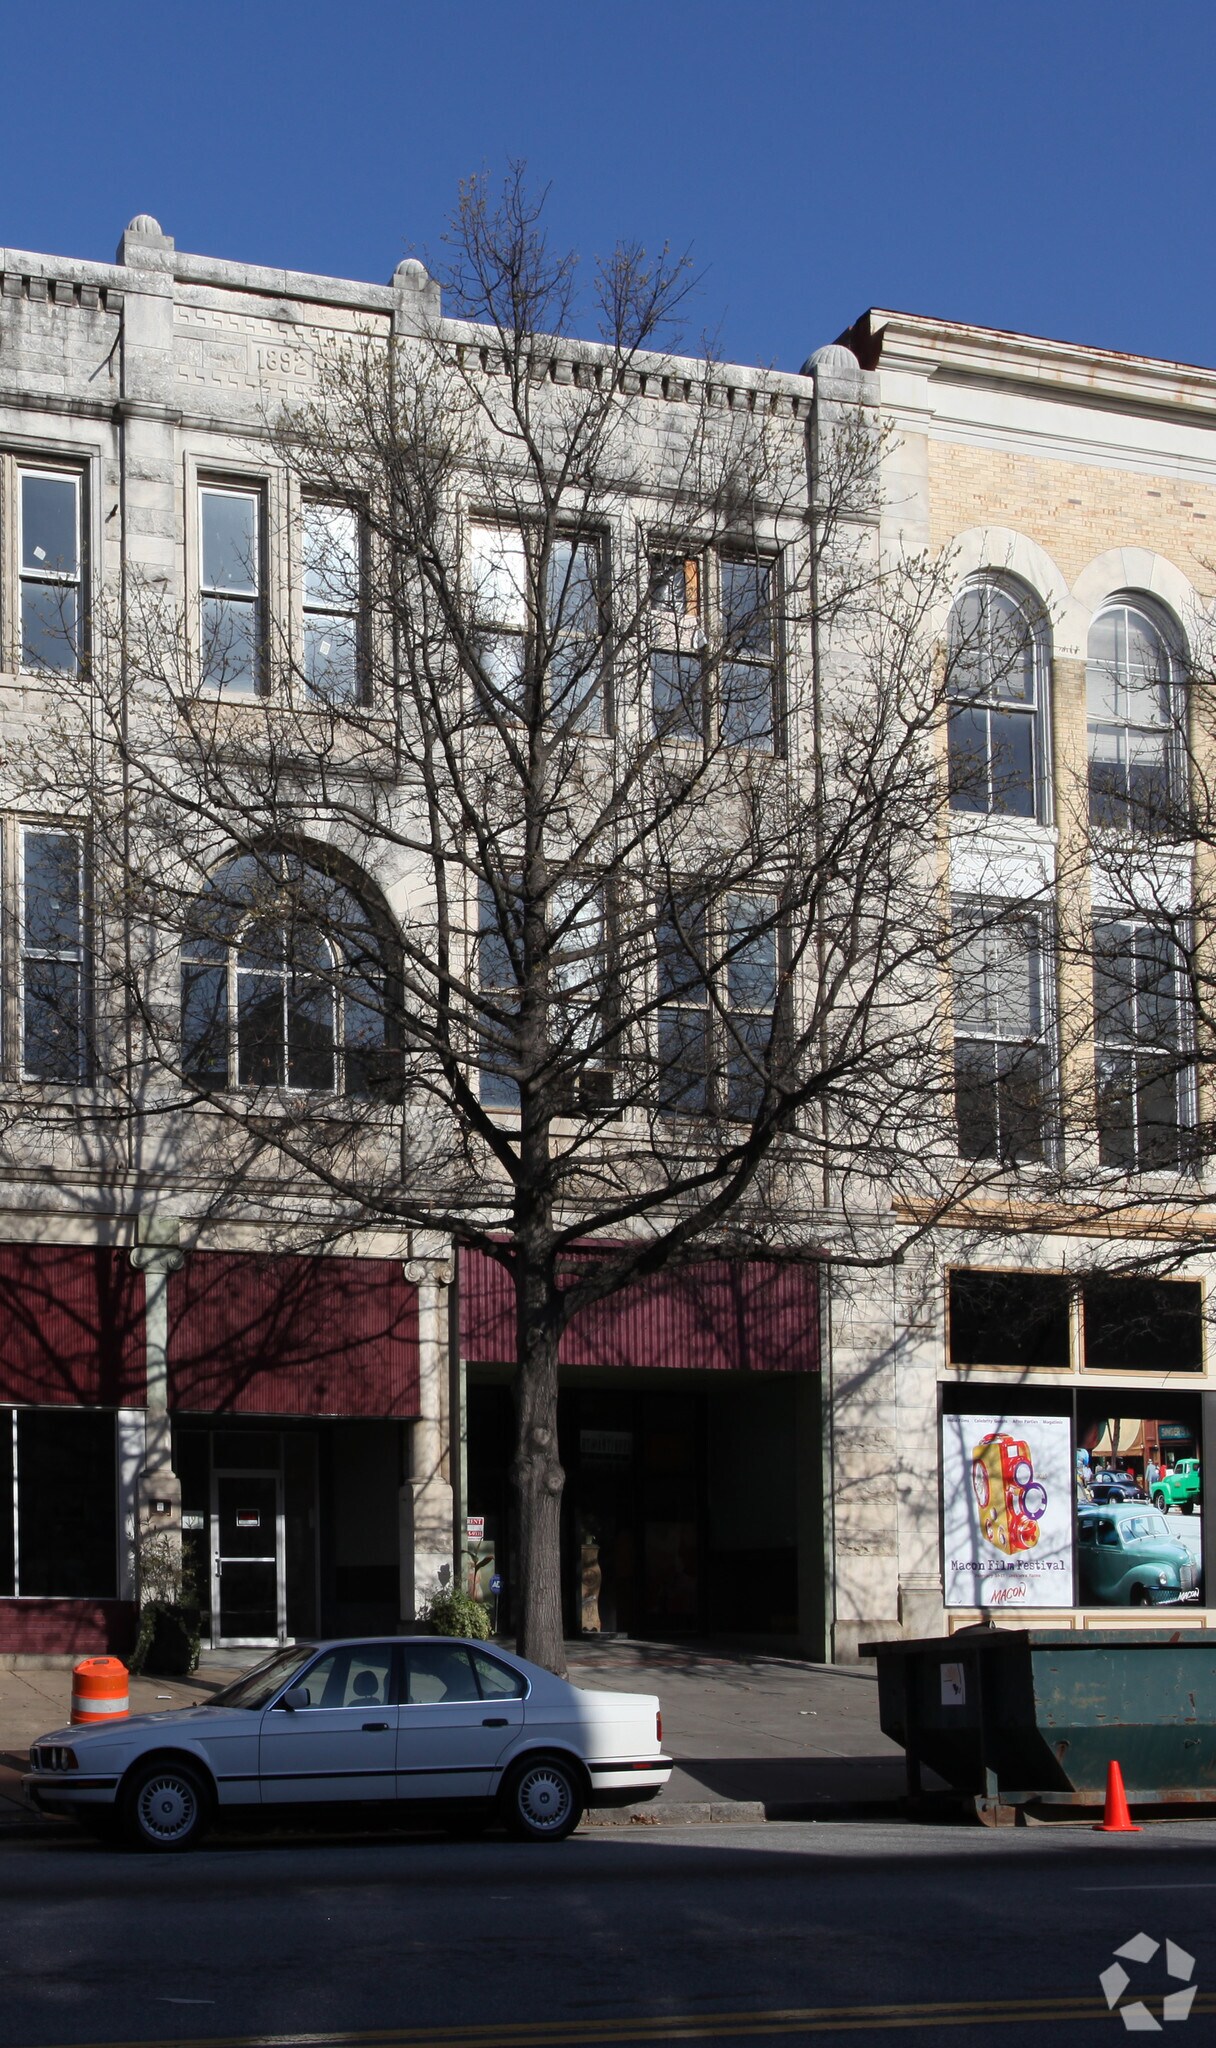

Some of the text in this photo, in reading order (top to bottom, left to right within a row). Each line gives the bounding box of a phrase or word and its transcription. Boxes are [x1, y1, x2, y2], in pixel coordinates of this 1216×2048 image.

[256, 349, 308, 377] 1892
[951, 1559, 1066, 1571] Macon Film Festival
[990, 1581, 1027, 1604] MACON
[1177, 1587, 1200, 1602] MACON
